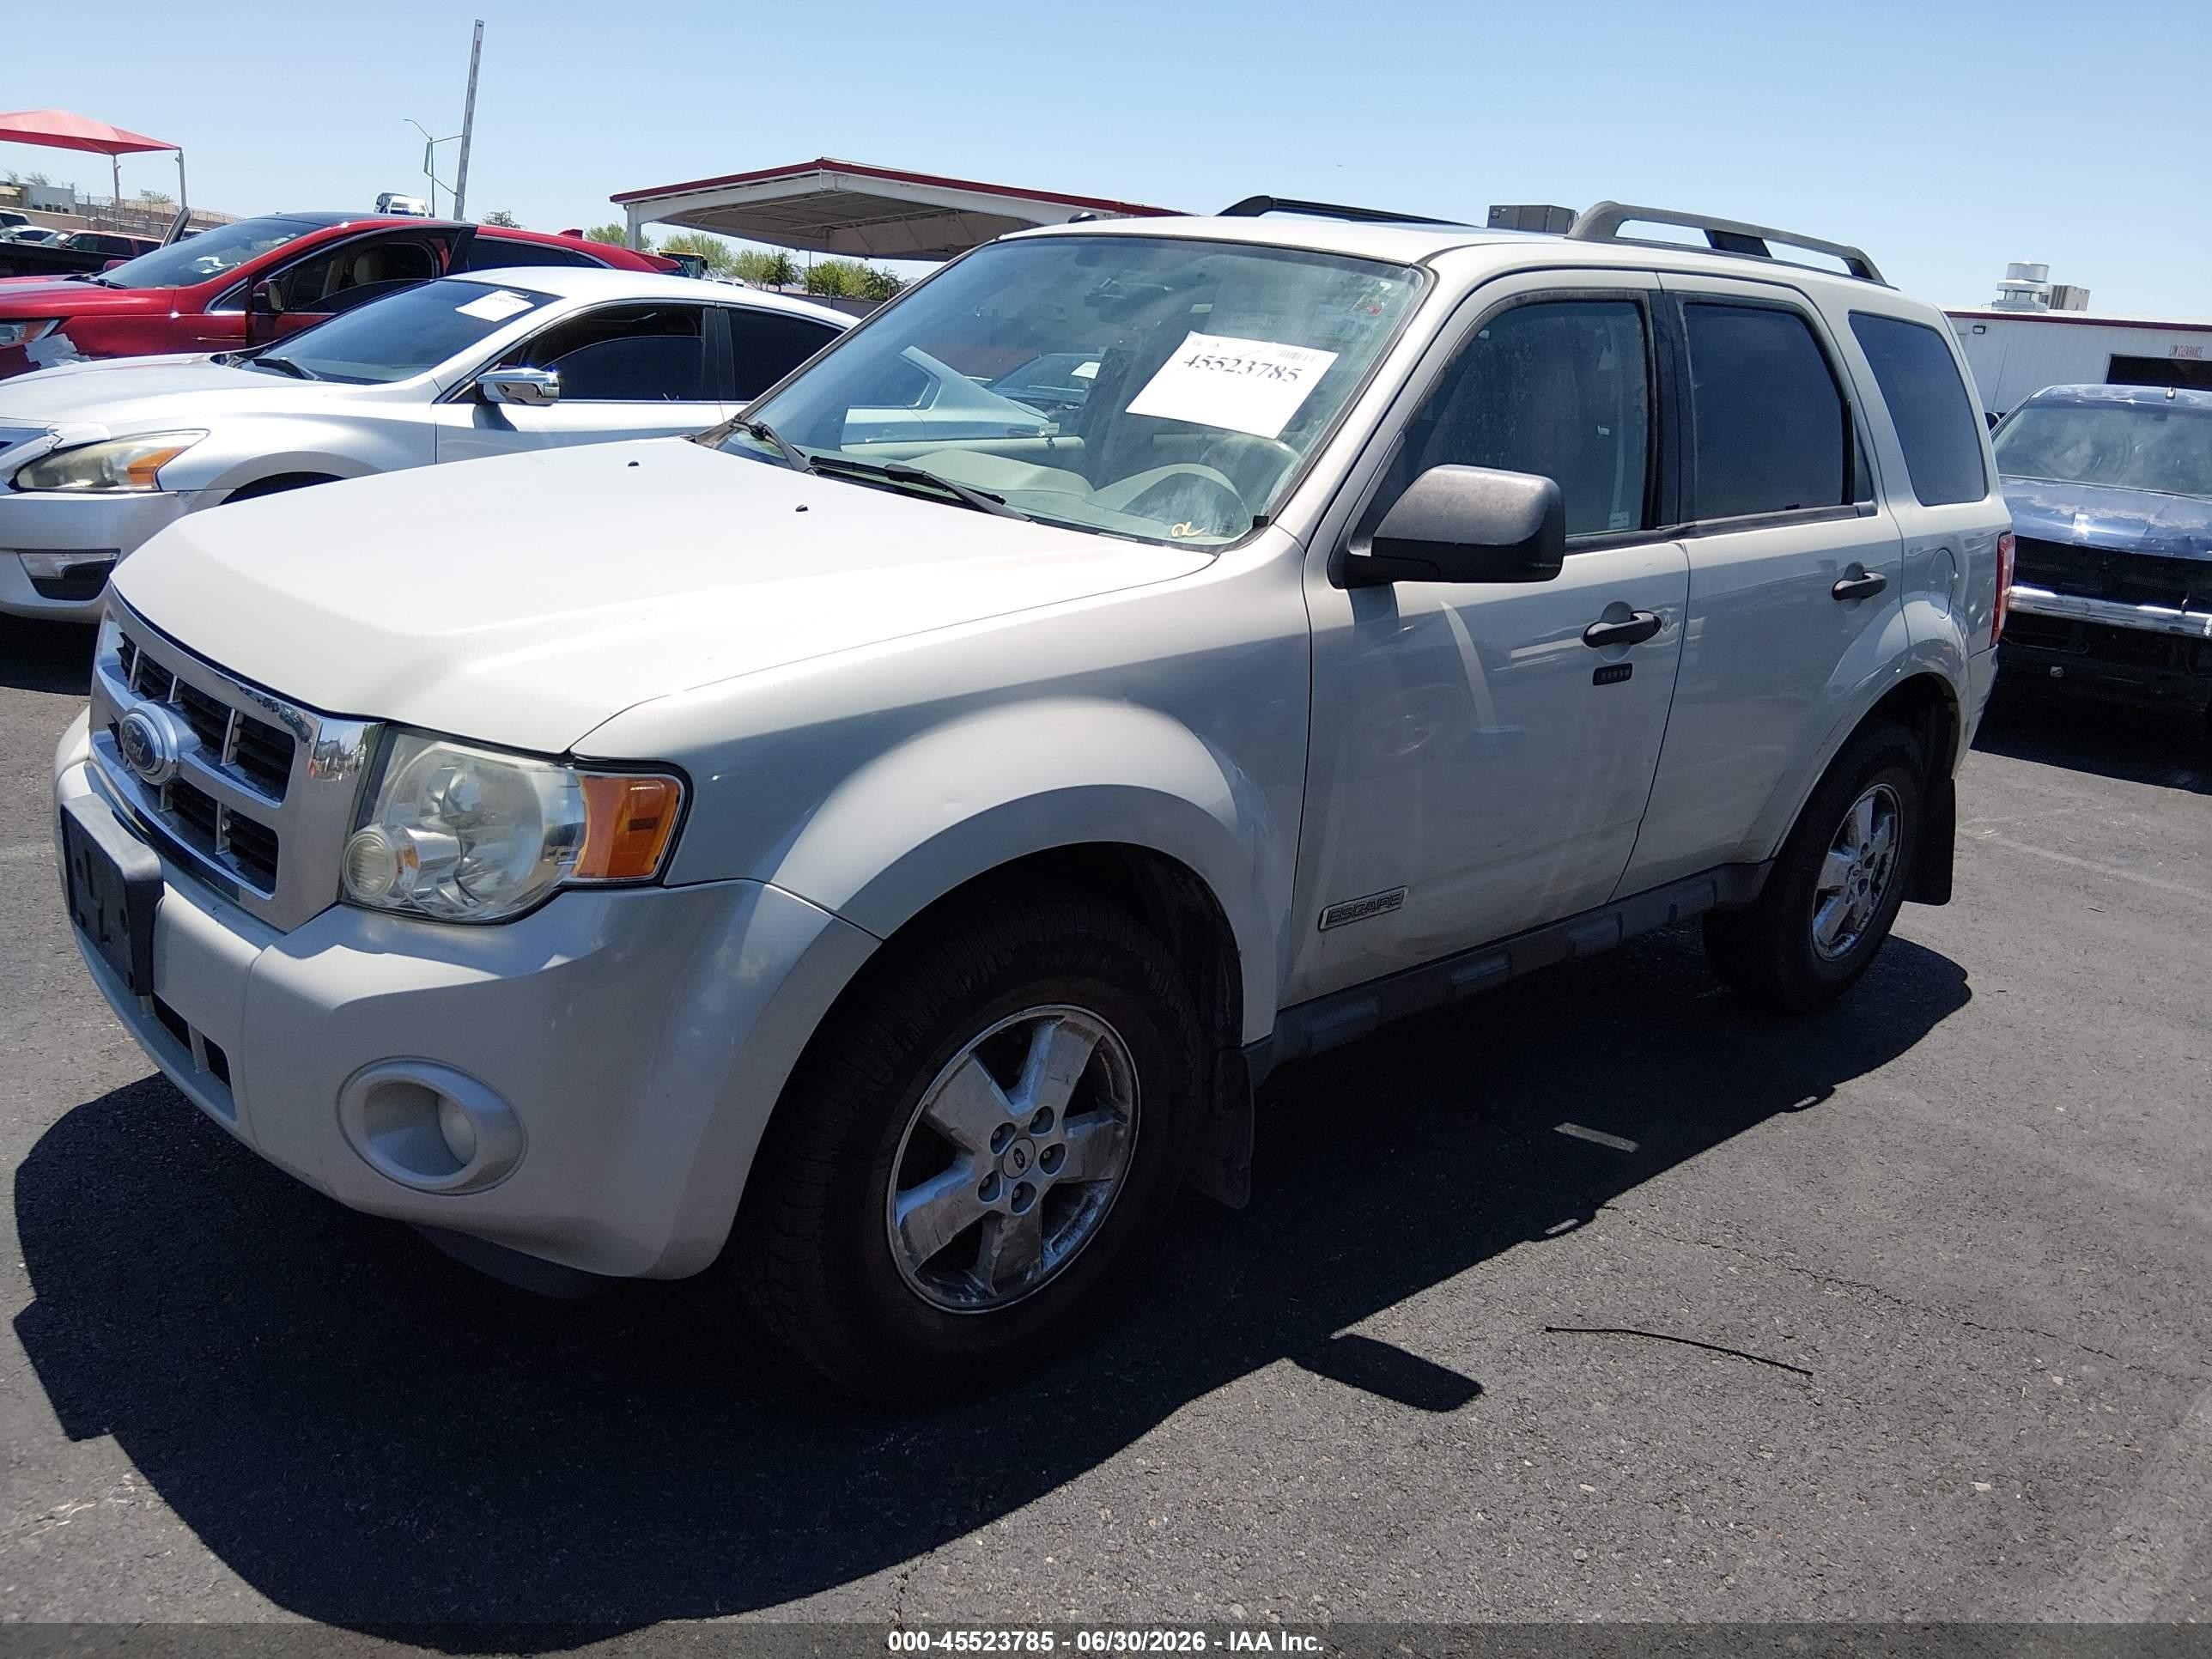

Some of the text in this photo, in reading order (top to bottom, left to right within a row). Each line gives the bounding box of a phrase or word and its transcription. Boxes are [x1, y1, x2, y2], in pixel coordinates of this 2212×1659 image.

[1183, 354, 1304, 383] 45523785
[123, 723, 147, 763] Ford
[1327, 892, 1403, 924] ESCAPE
